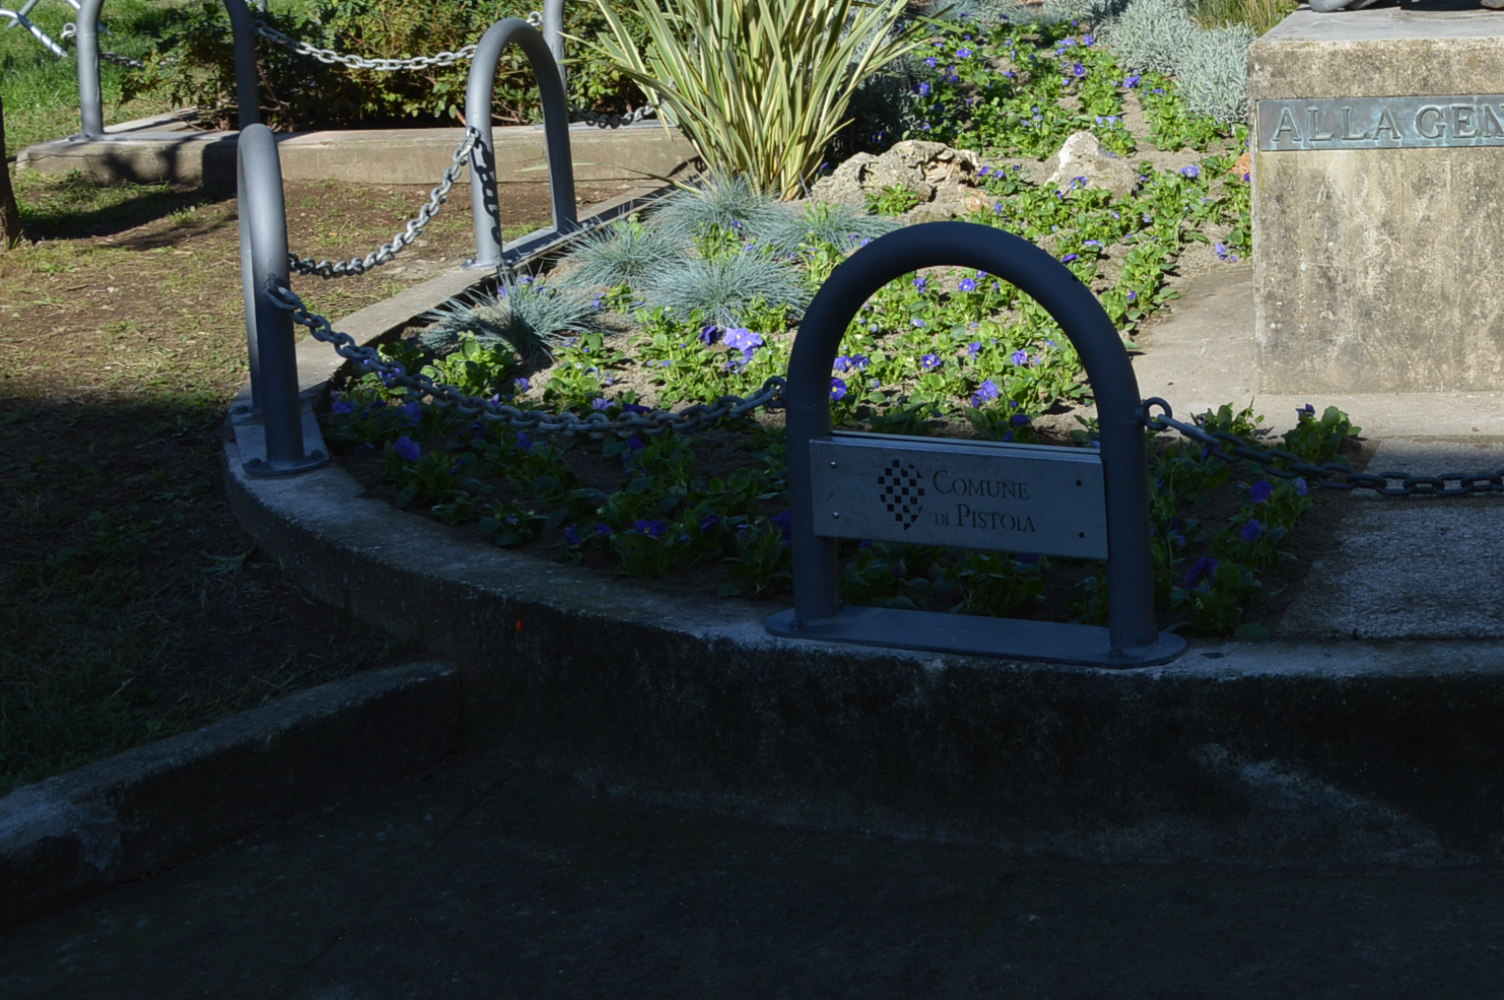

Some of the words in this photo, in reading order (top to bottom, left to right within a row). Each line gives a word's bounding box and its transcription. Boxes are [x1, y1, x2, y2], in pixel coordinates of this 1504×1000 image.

[1270, 105, 1402, 143] ALLA
[932, 469, 1031, 501] COMUNE
[957, 503, 1037, 533] PISTOIA
